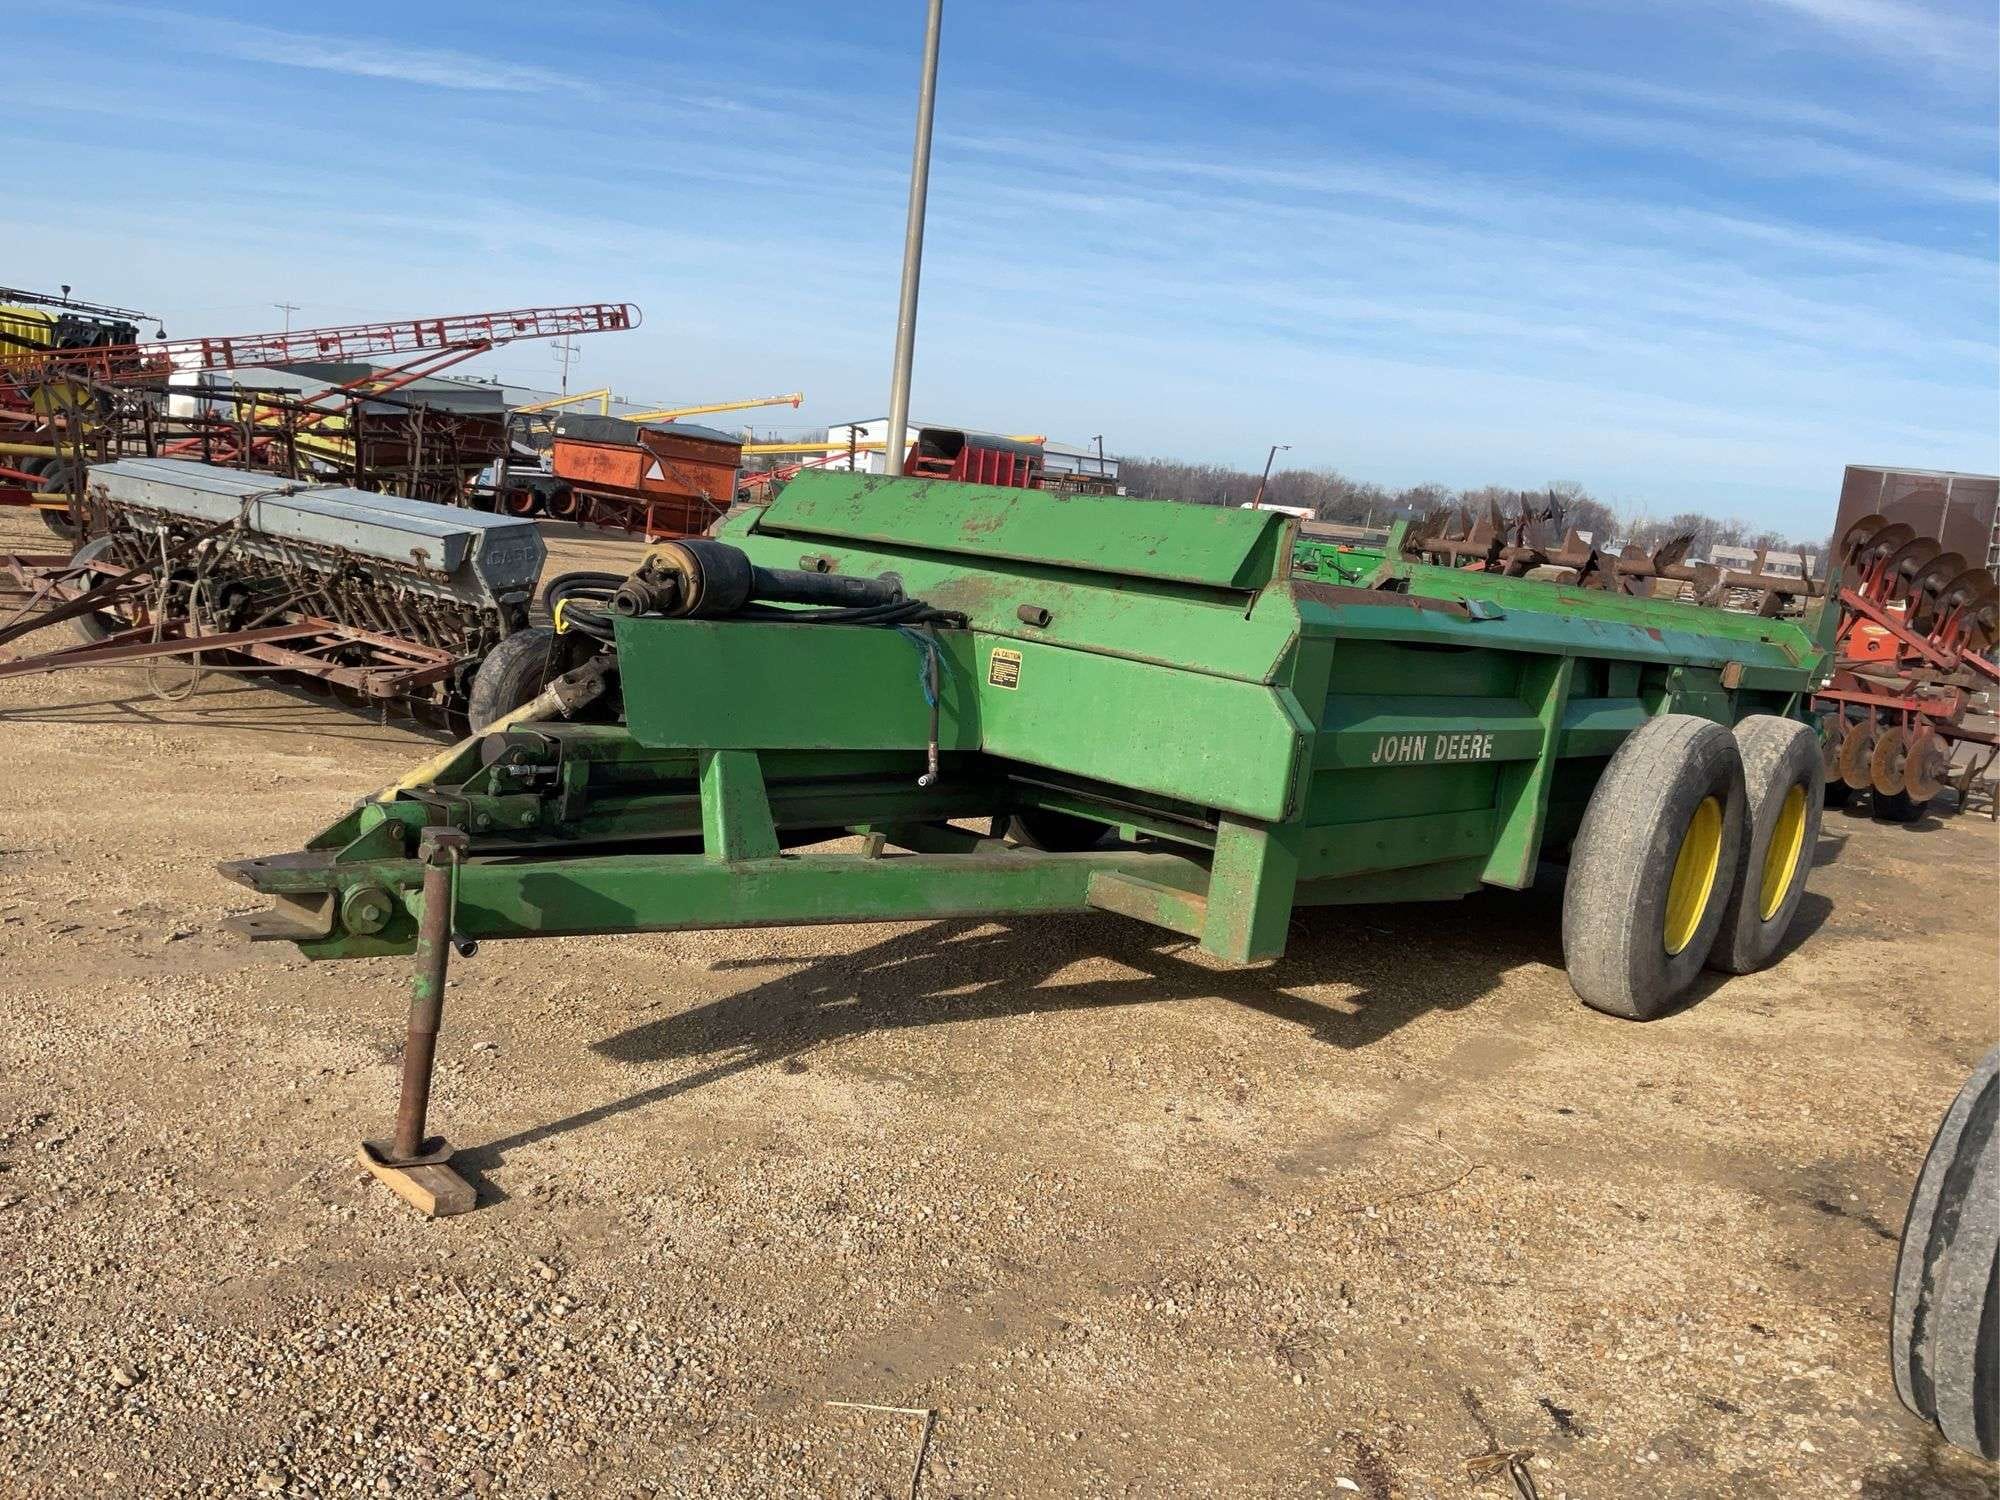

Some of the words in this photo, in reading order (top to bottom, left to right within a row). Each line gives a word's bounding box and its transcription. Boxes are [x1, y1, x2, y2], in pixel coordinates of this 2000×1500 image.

[488, 546, 534, 566] CASE
[1001, 650, 1021, 660] CAUTION
[1371, 735, 1428, 763] JOHN
[1434, 734, 1495, 760] DEERE
